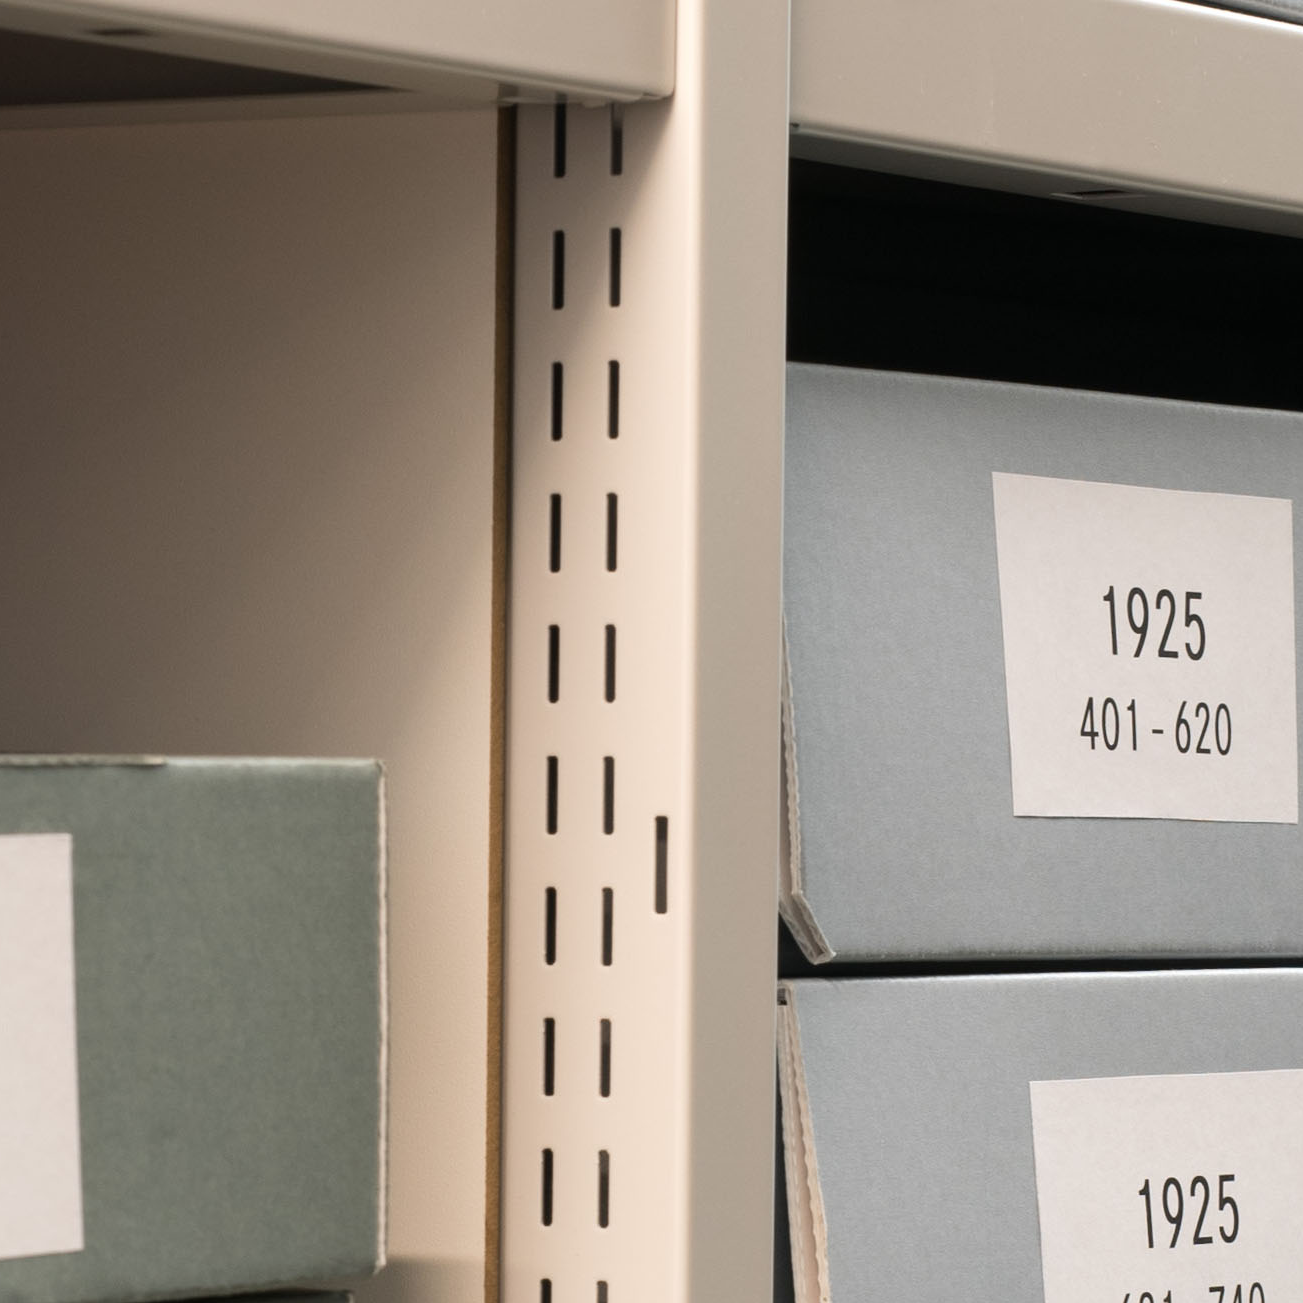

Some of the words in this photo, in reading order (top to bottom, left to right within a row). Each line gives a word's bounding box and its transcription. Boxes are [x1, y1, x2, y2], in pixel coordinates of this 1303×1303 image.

[1103, 586, 1205, 660] 1925
[1080, 697, 1231, 755] 401-620
[1139, 1174, 1239, 1248] 1925
